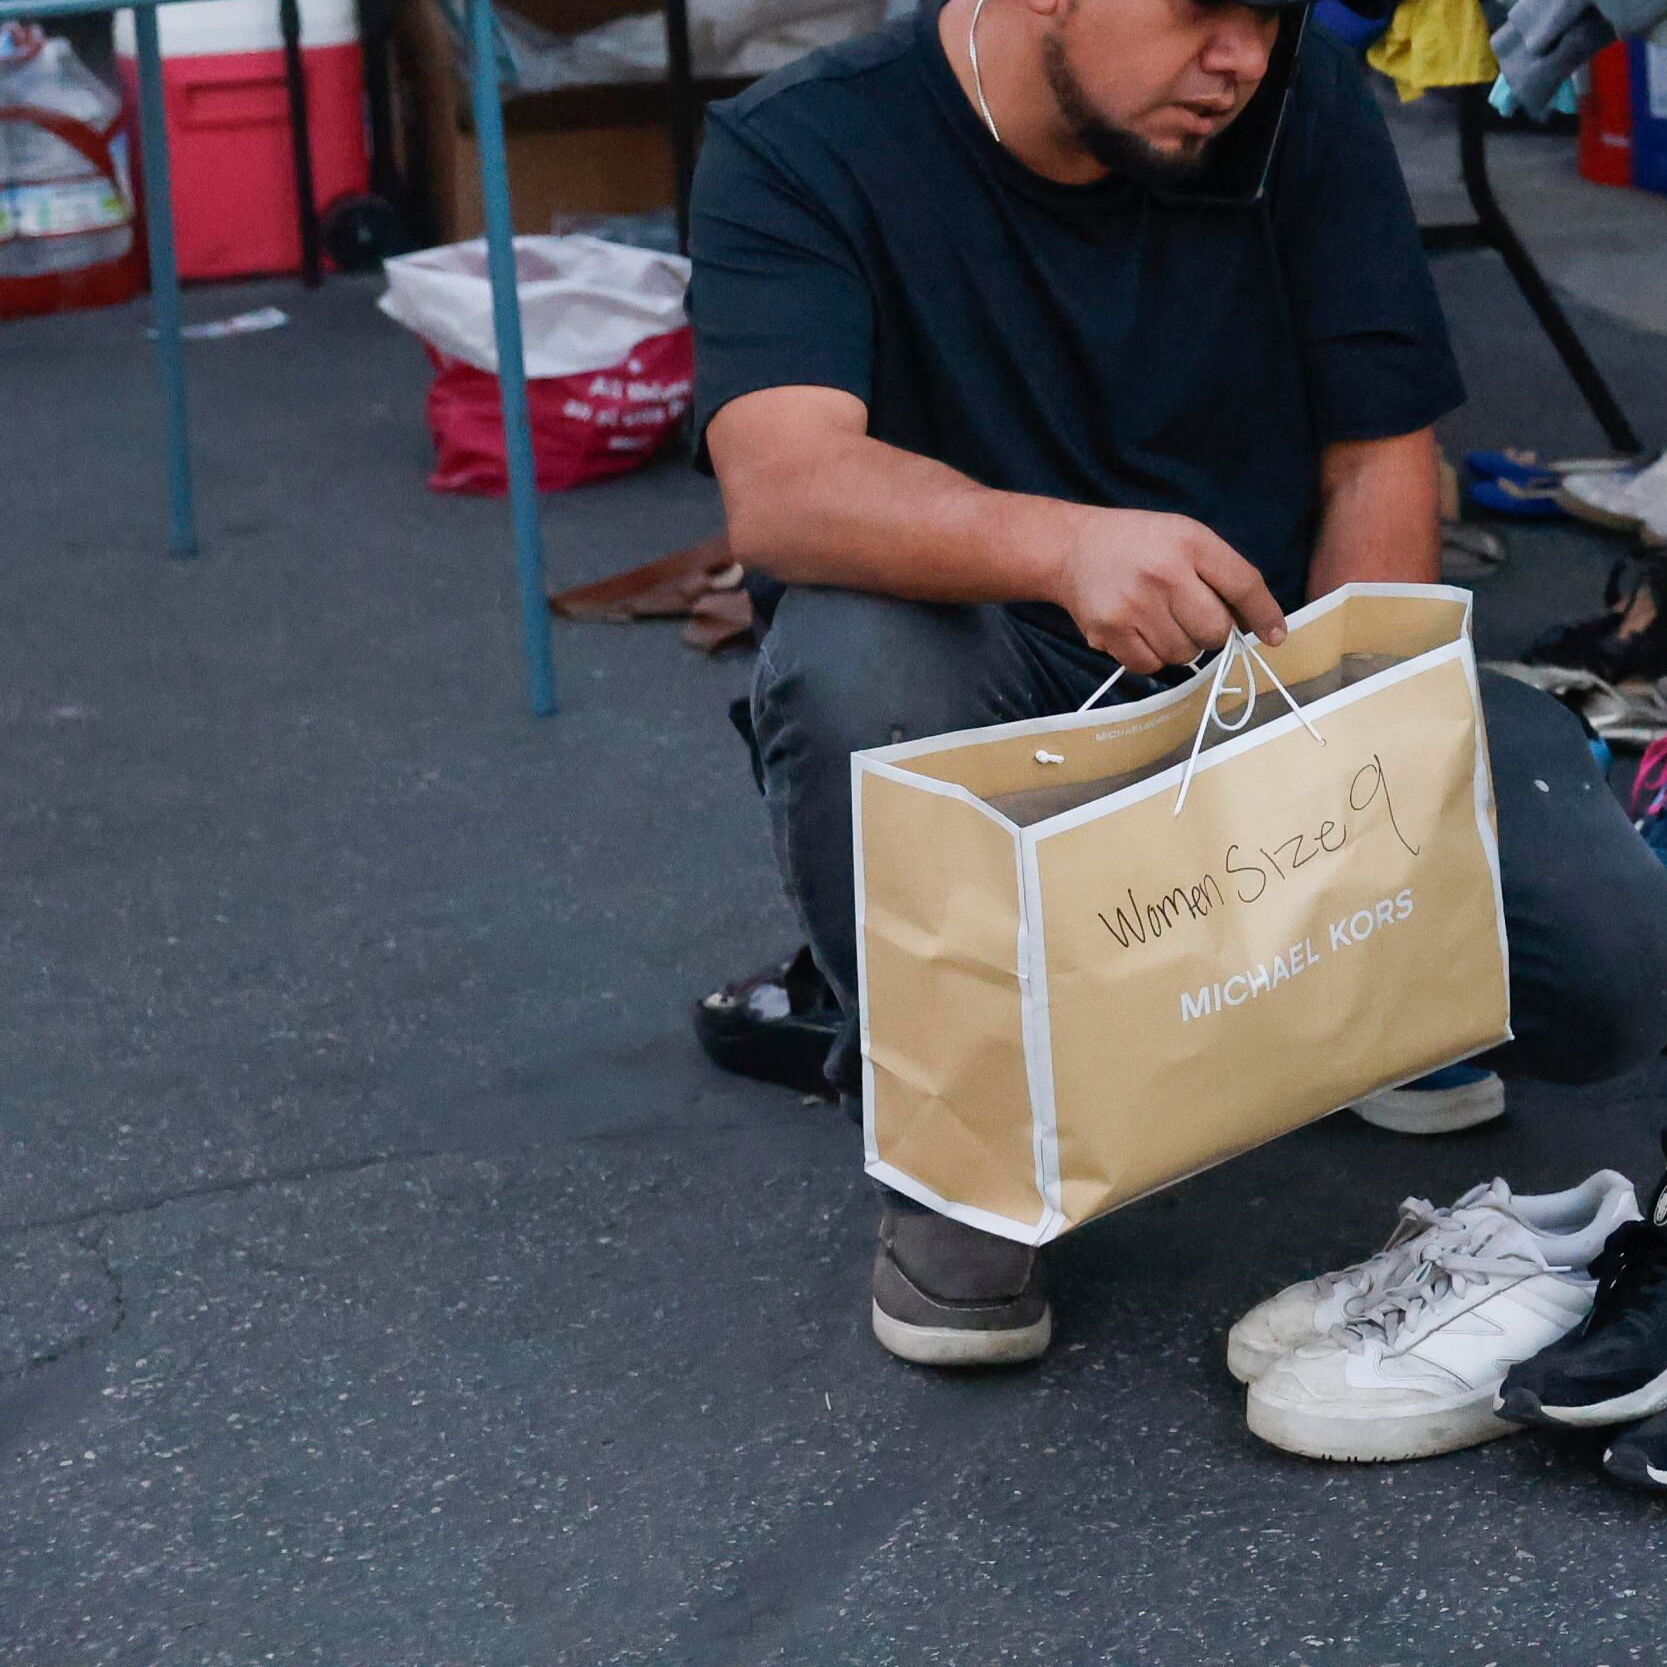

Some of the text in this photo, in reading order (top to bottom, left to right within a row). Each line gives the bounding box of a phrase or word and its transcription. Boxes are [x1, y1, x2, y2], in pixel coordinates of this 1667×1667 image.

[1098, 753, 1420, 949] Women Size 9
[1180, 888, 1415, 1022] MICHAEL KORS
